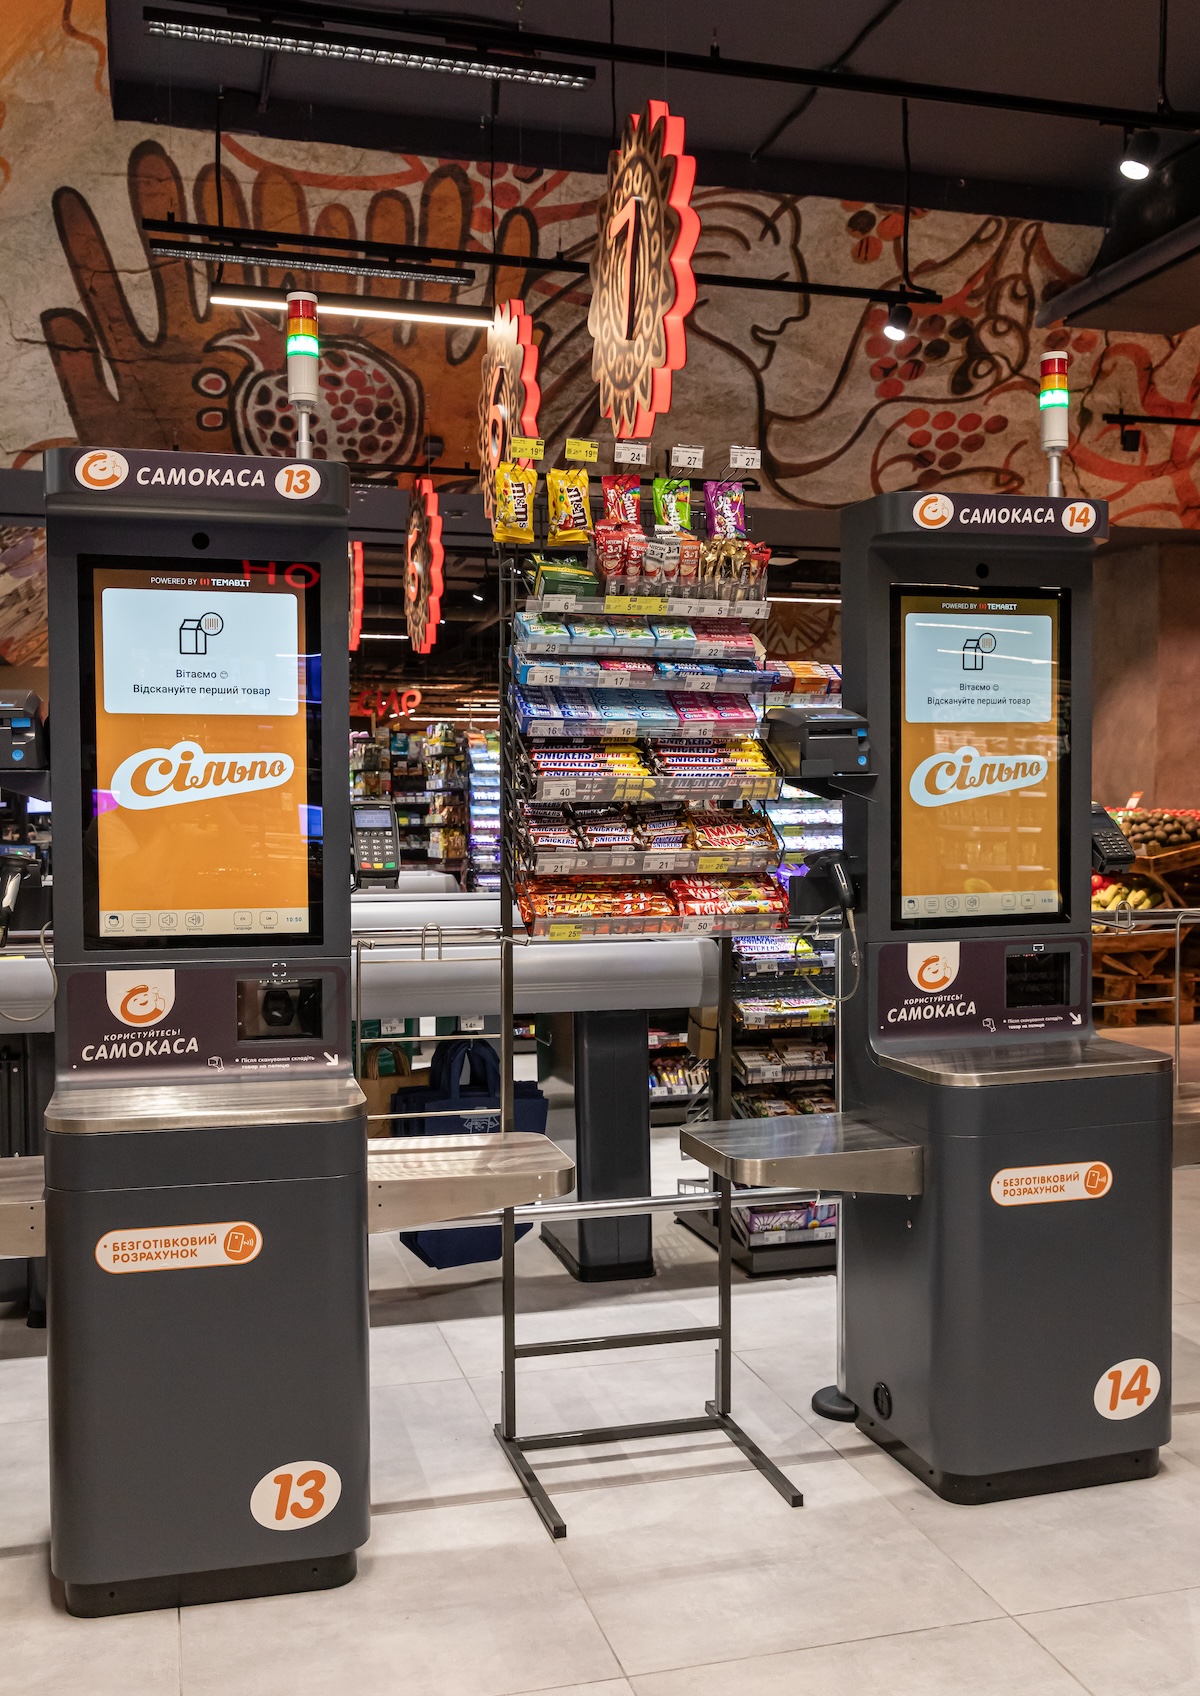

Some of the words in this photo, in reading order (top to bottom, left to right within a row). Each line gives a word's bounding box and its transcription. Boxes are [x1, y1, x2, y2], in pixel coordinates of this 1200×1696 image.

[630, 452, 641, 462] 24
[687, 456, 697, 466] 27
[745, 458, 755, 467] 27
[136, 466, 266, 488] САМОКАСА
[284, 469, 311, 494] 13
[959, 507, 1055, 524] САМОКАСА
[1068, 506, 1091, 527] 14
[150, 576, 186, 585] POWERED
[187, 578, 198, 586] BY
[211, 578, 251, 587] TEMABIT
[563, 601, 569, 610] 6
[687, 605, 693, 614] 7
[941, 602, 969, 610] POWERED
[987, 603, 1018, 611] TEMABIT
[717, 606, 723, 615] 5
[755, 607, 761, 615] 4
[545, 644, 556, 653] 29
[708, 648, 719, 657] 22
[176, 669, 217, 679] Вітаємо
[544, 674, 554, 683] 15
[614, 677, 624, 686] 17
[700, 682, 711, 690] 22
[133, 684, 197, 695] Відскануйте
[199, 685, 239, 697] перший
[241, 687, 271, 697] товар
[959, 683, 991, 691] Вітаємо
[927, 697, 975, 706] Відскануйте
[976, 697, 1007, 706] перший
[1009, 698, 1031, 706] товар
[547, 727, 557, 735] 16
[621, 728, 631, 736] 16
[698, 728, 708, 736] 16
[536, 752, 593, 760] SNICKERS
[130, 751, 287, 798] Сільпо
[924, 754, 1043, 796] Сільпо
[559, 788, 570, 797] 40
[648, 821, 676, 829] SNICKERS
[697, 823, 745, 839] TWIX
[539, 837, 575, 845] SNICKERS
[553, 865, 563, 873] 21
[658, 861, 668, 869] 21
[623, 903, 645, 913] 2+1
[697, 922, 708, 930] 50
[903, 994, 963, 1005] КОРИСТУЙТЕСЬ!
[887, 1001, 977, 1023] САМОКАСА
[103, 1028, 181, 1041] КОРИСТУЙТЕСЬ!
[81, 1037, 199, 1061] САМОКАСА
[1003, 1171, 1080, 1188] БЕЗГОТІВКОВИЙ
[1002, 1184, 1065, 1198] РОЗРАХУНОК
[112, 1233, 217, 1252] БЕЗГОТІВКОВИЙ
[112, 1248, 199, 1264] РОЗРАХУНОК
[1107, 1364, 1151, 1411] 14
[273, 1469, 327, 1521] 13
